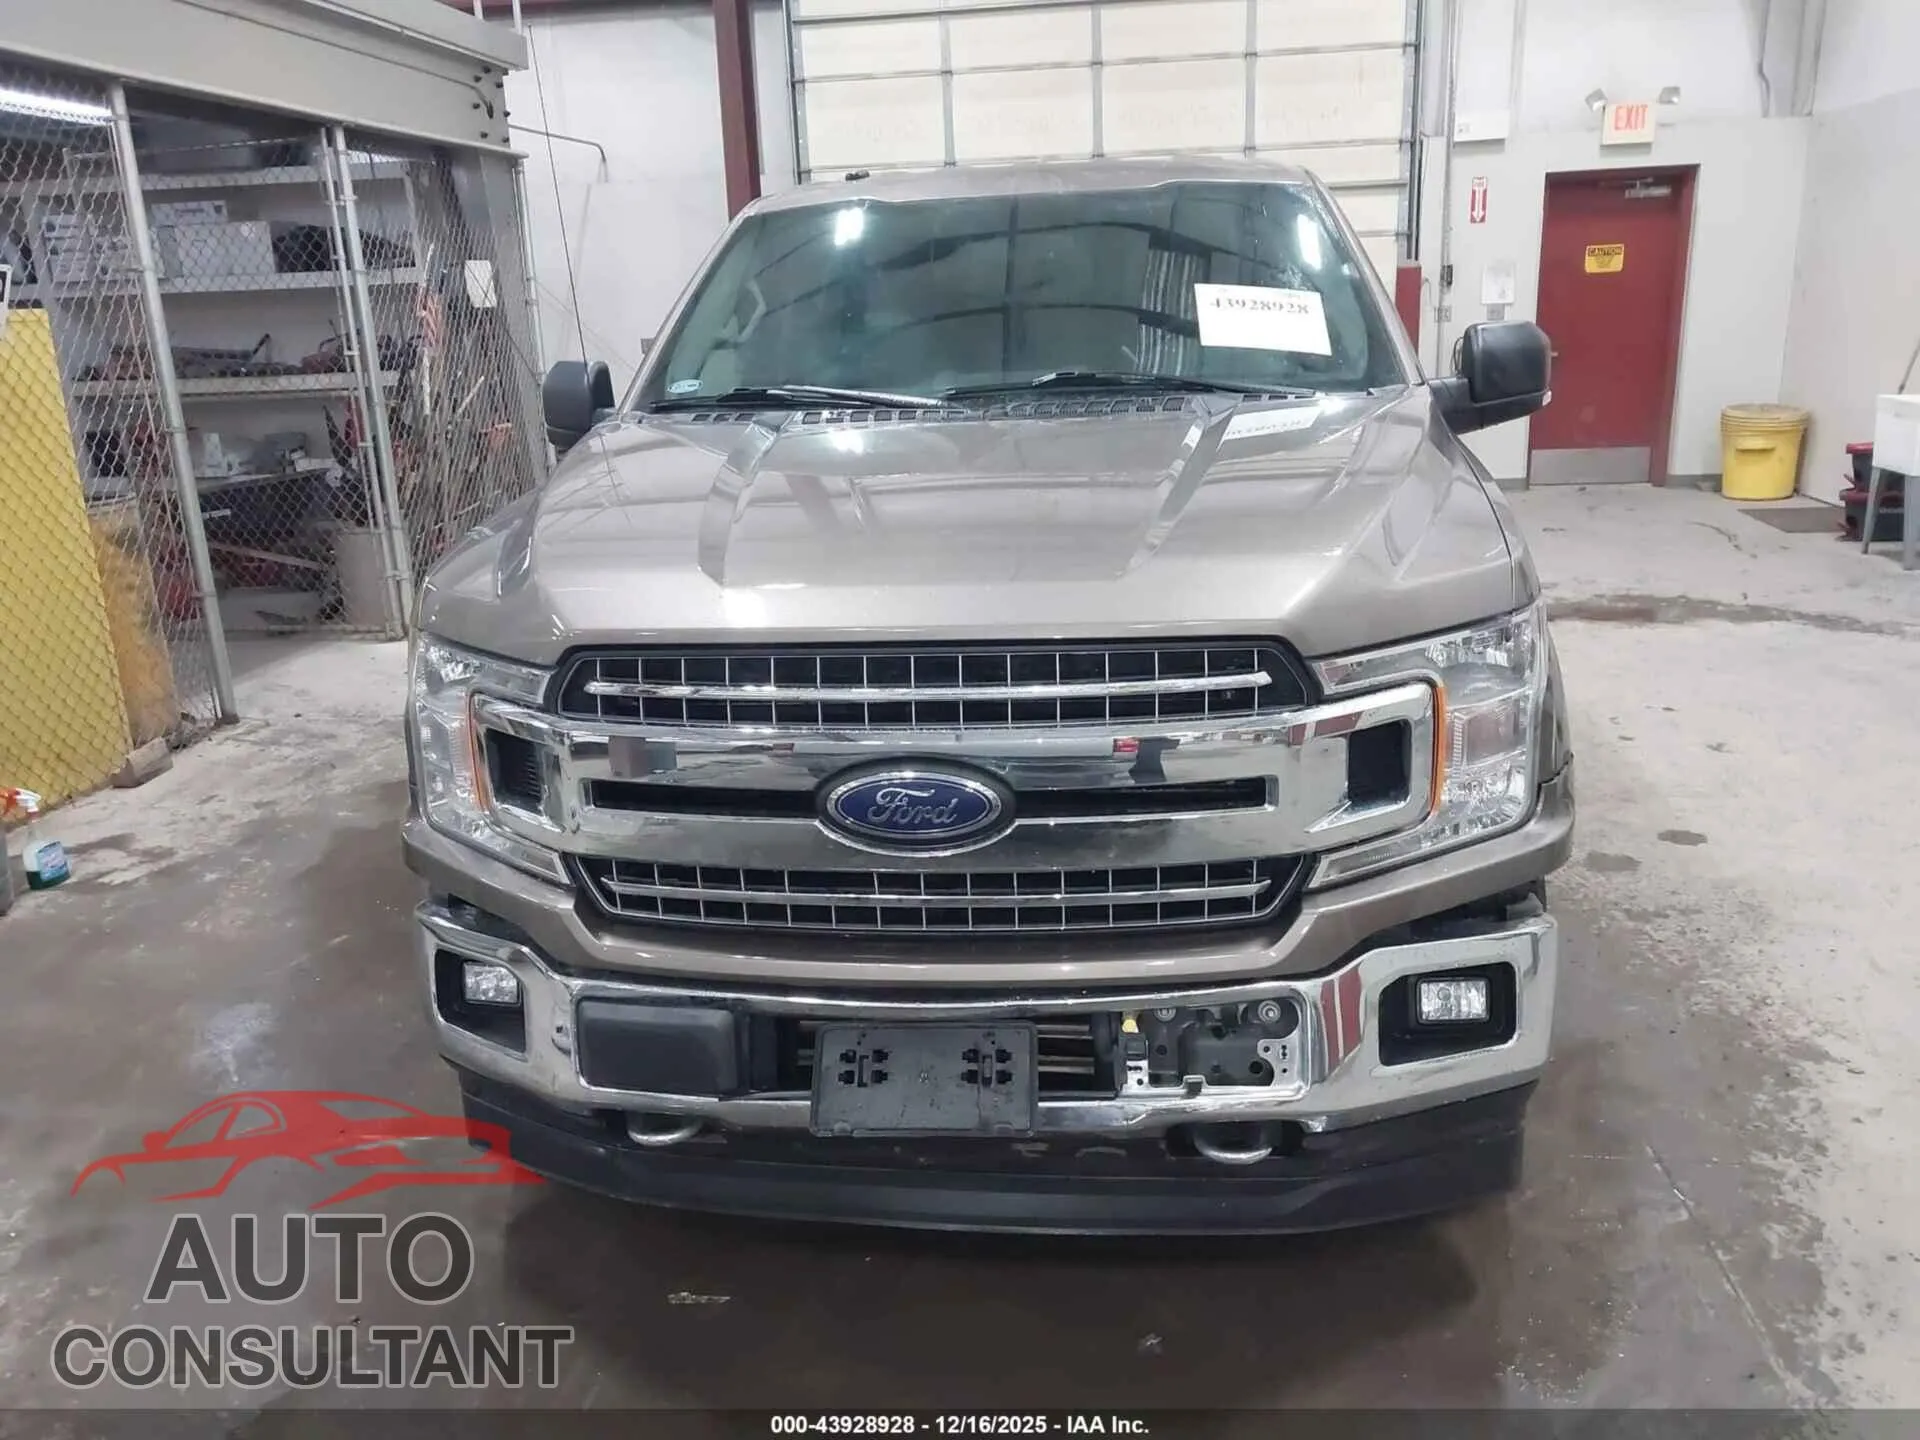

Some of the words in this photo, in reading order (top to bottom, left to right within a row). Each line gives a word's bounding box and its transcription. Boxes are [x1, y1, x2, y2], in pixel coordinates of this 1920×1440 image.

[1613, 104, 1649, 131] EXIT
[1208, 297, 1311, 315] 43928928
[866, 786, 959, 824] Ford
